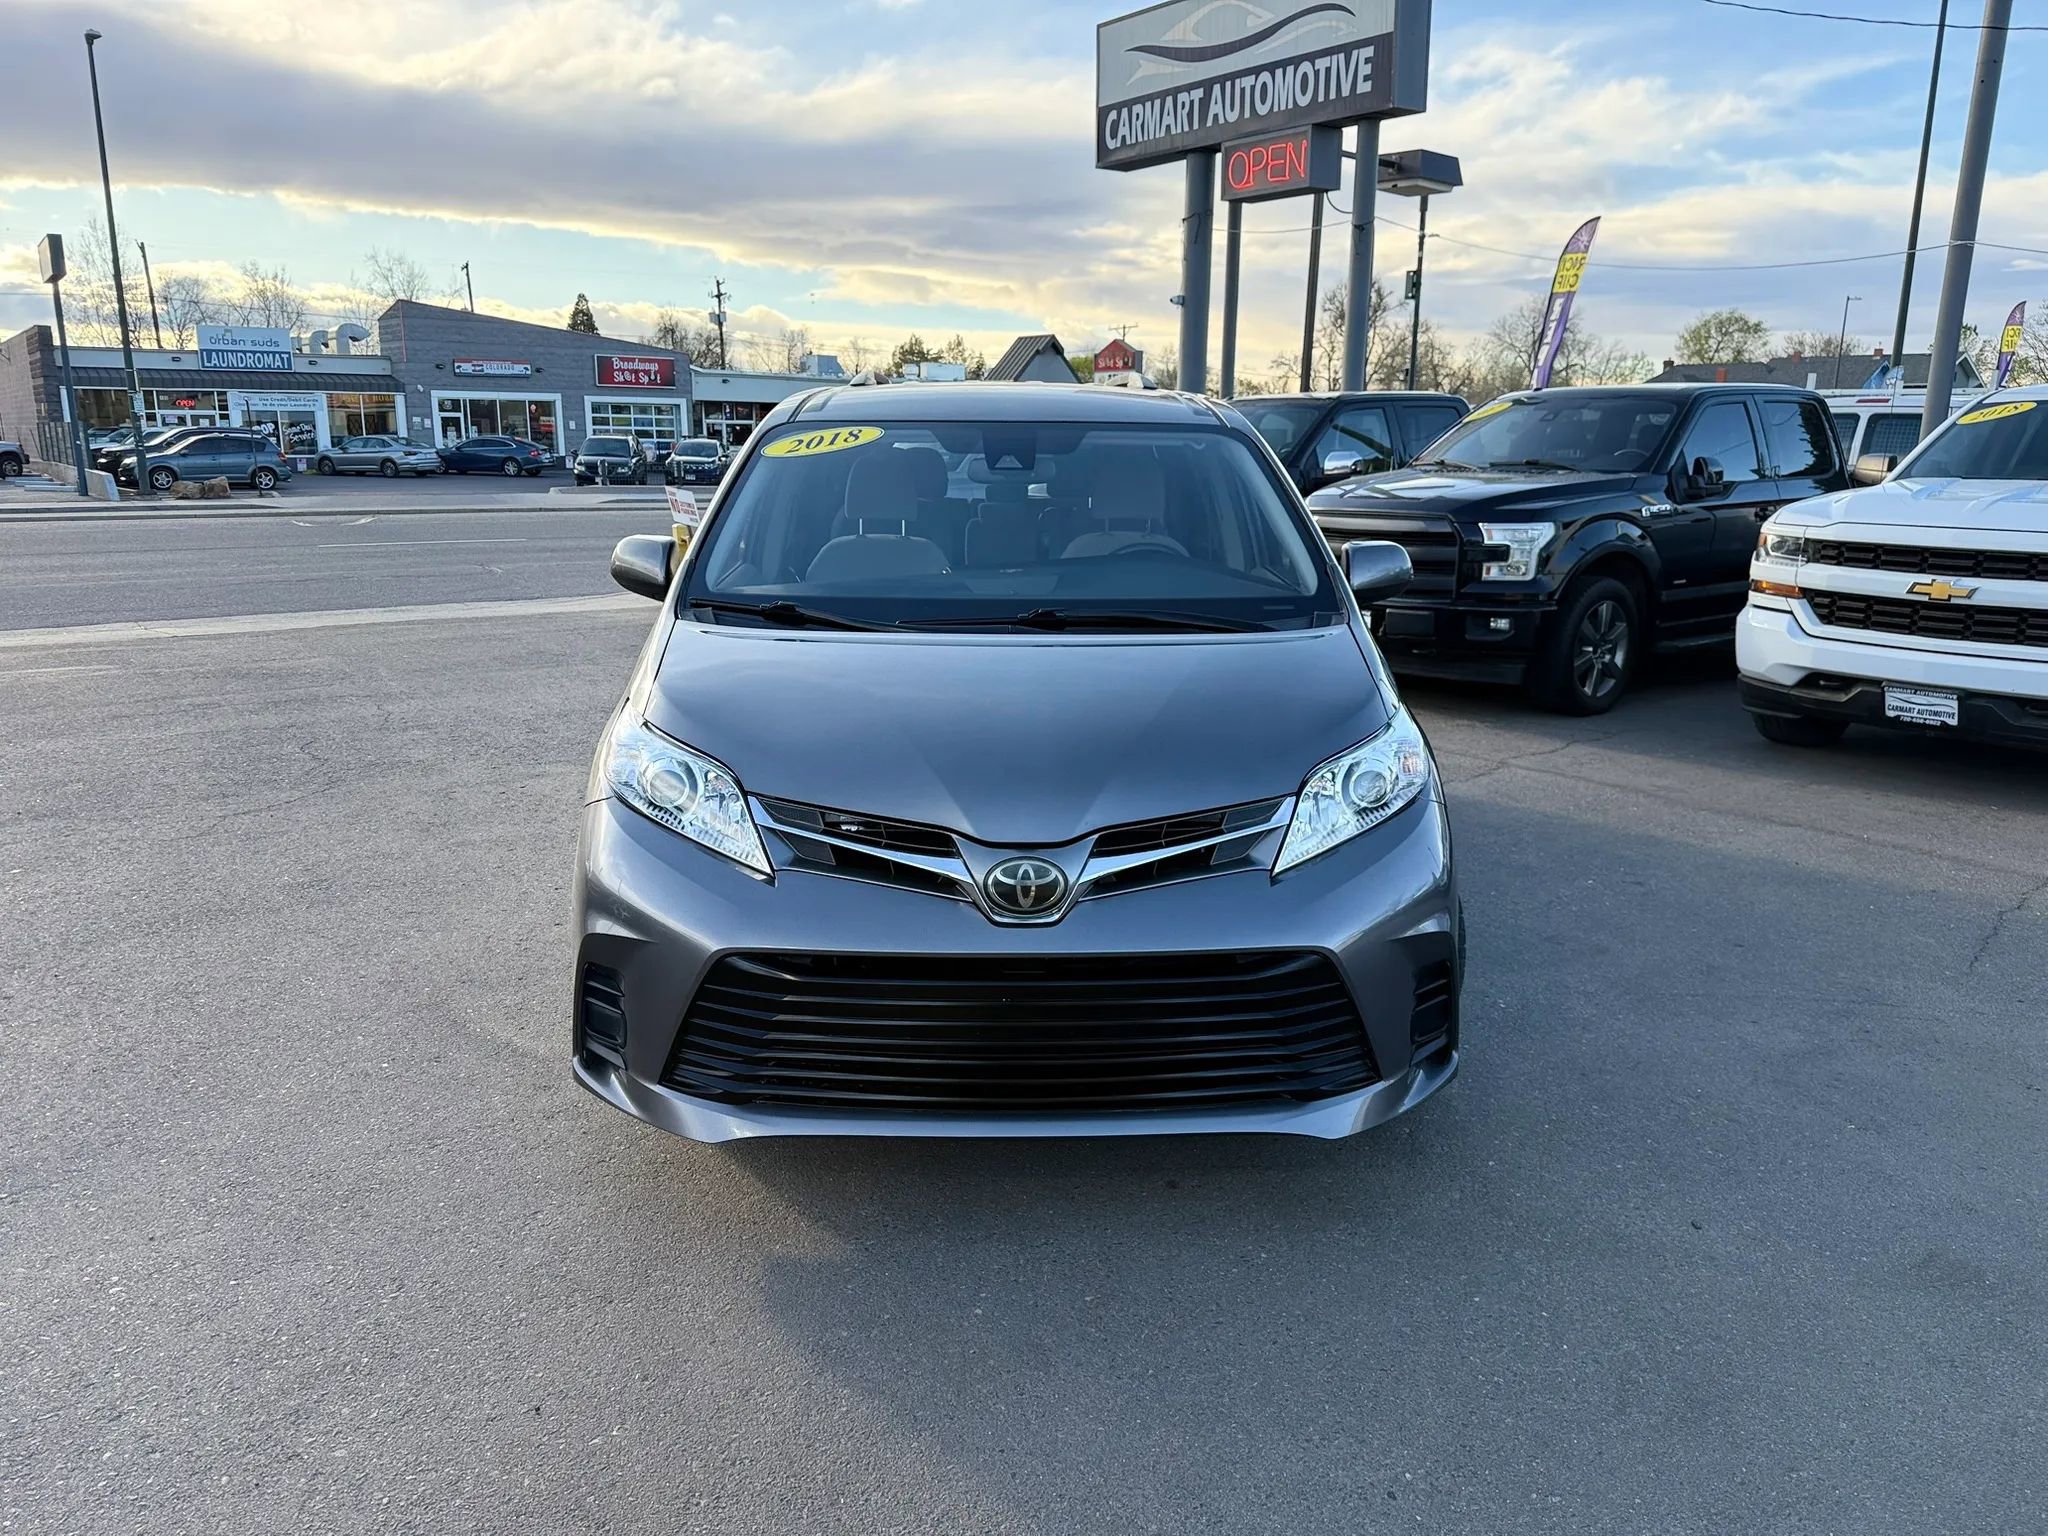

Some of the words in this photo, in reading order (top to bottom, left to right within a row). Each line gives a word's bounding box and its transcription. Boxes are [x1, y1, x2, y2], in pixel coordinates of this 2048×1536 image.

[1105, 87, 1204, 150] CARMART
[1206, 45, 1375, 127] AUTOMOTIVE
[1227, 138, 1308, 191] OPEN
[250, 338, 280, 347] suds
[203, 351, 289, 368] LAUNDROMAT
[611, 357, 659, 371] Broadways
[175, 399, 195, 407] OPEN
[784, 428, 863, 454] 2018
[1887, 703, 1916, 715] CARMART
[1917, 708, 1956, 720] AUTOMOTIVE
